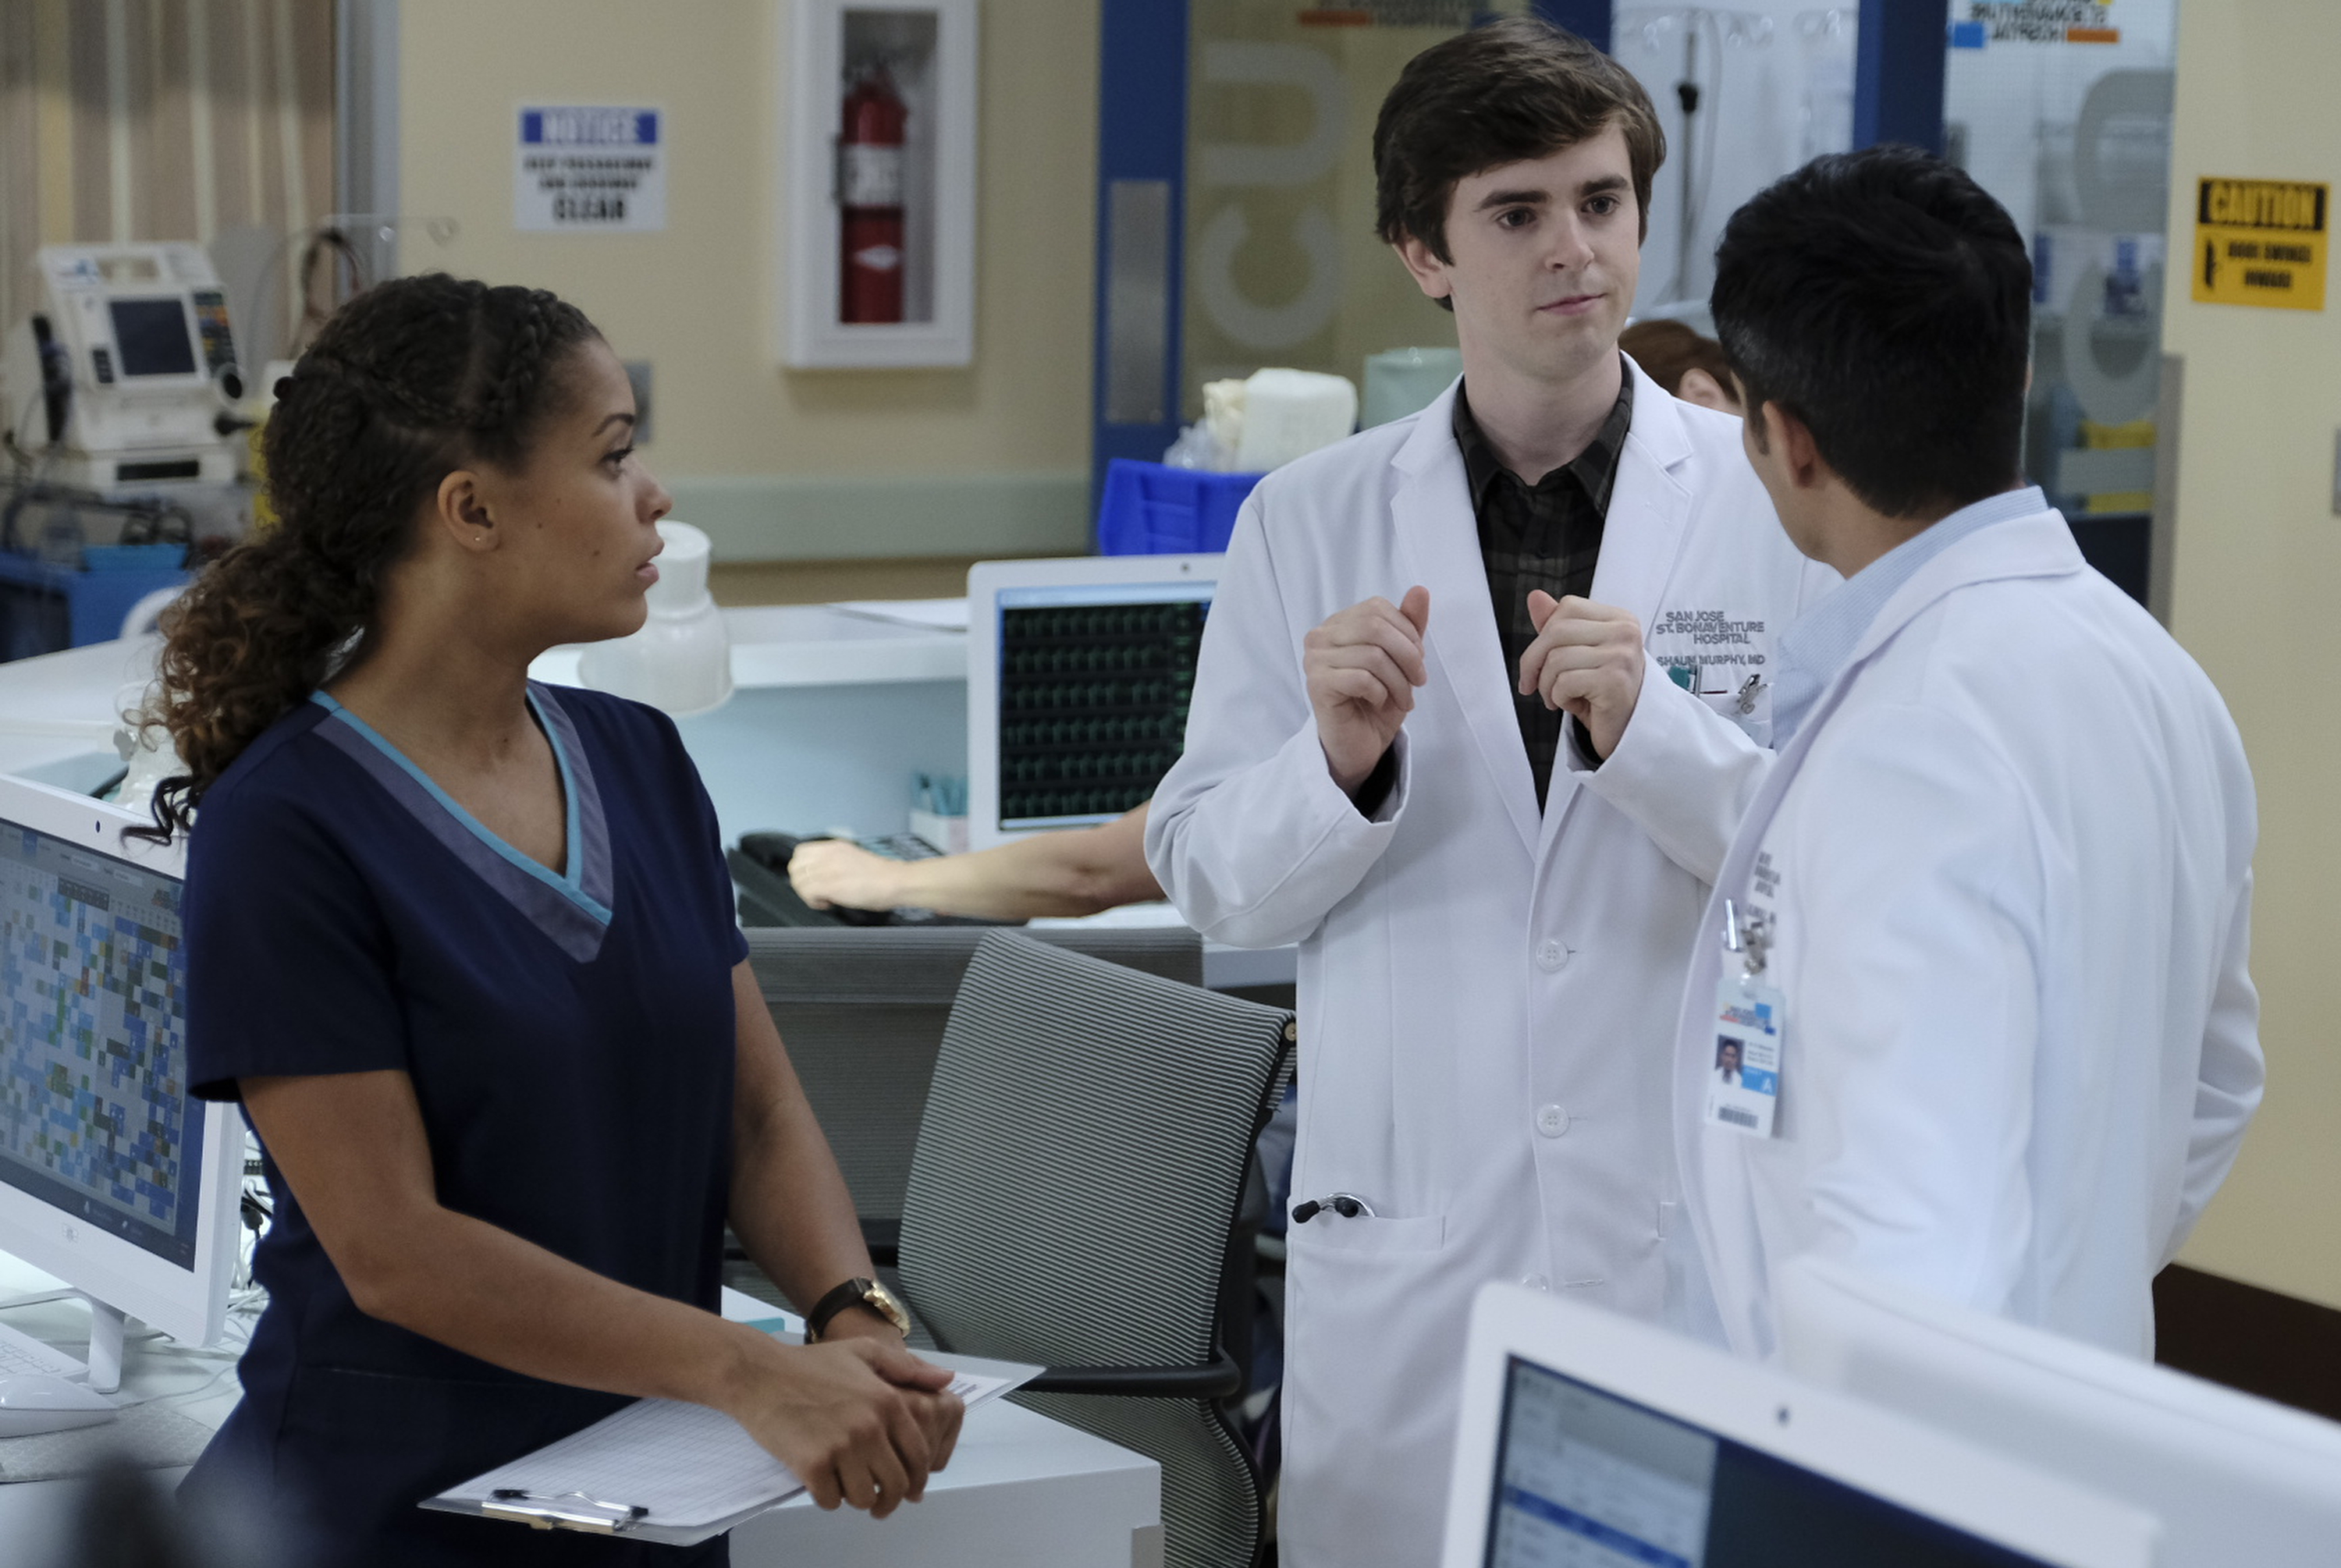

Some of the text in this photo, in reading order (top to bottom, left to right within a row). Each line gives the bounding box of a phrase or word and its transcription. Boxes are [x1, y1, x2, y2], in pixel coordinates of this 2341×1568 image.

[2209, 180, 2316, 229] CAUTION
[1198, 41, 1348, 384] CU
[1665, 611, 1725, 623] SAN JOSE
[1656, 622, 1764, 634] ST. BONAVENTURE
[1693, 633, 1751, 644] HOSPITAL
[1656, 655, 1765, 666] SHAUN MURPHY, MD
